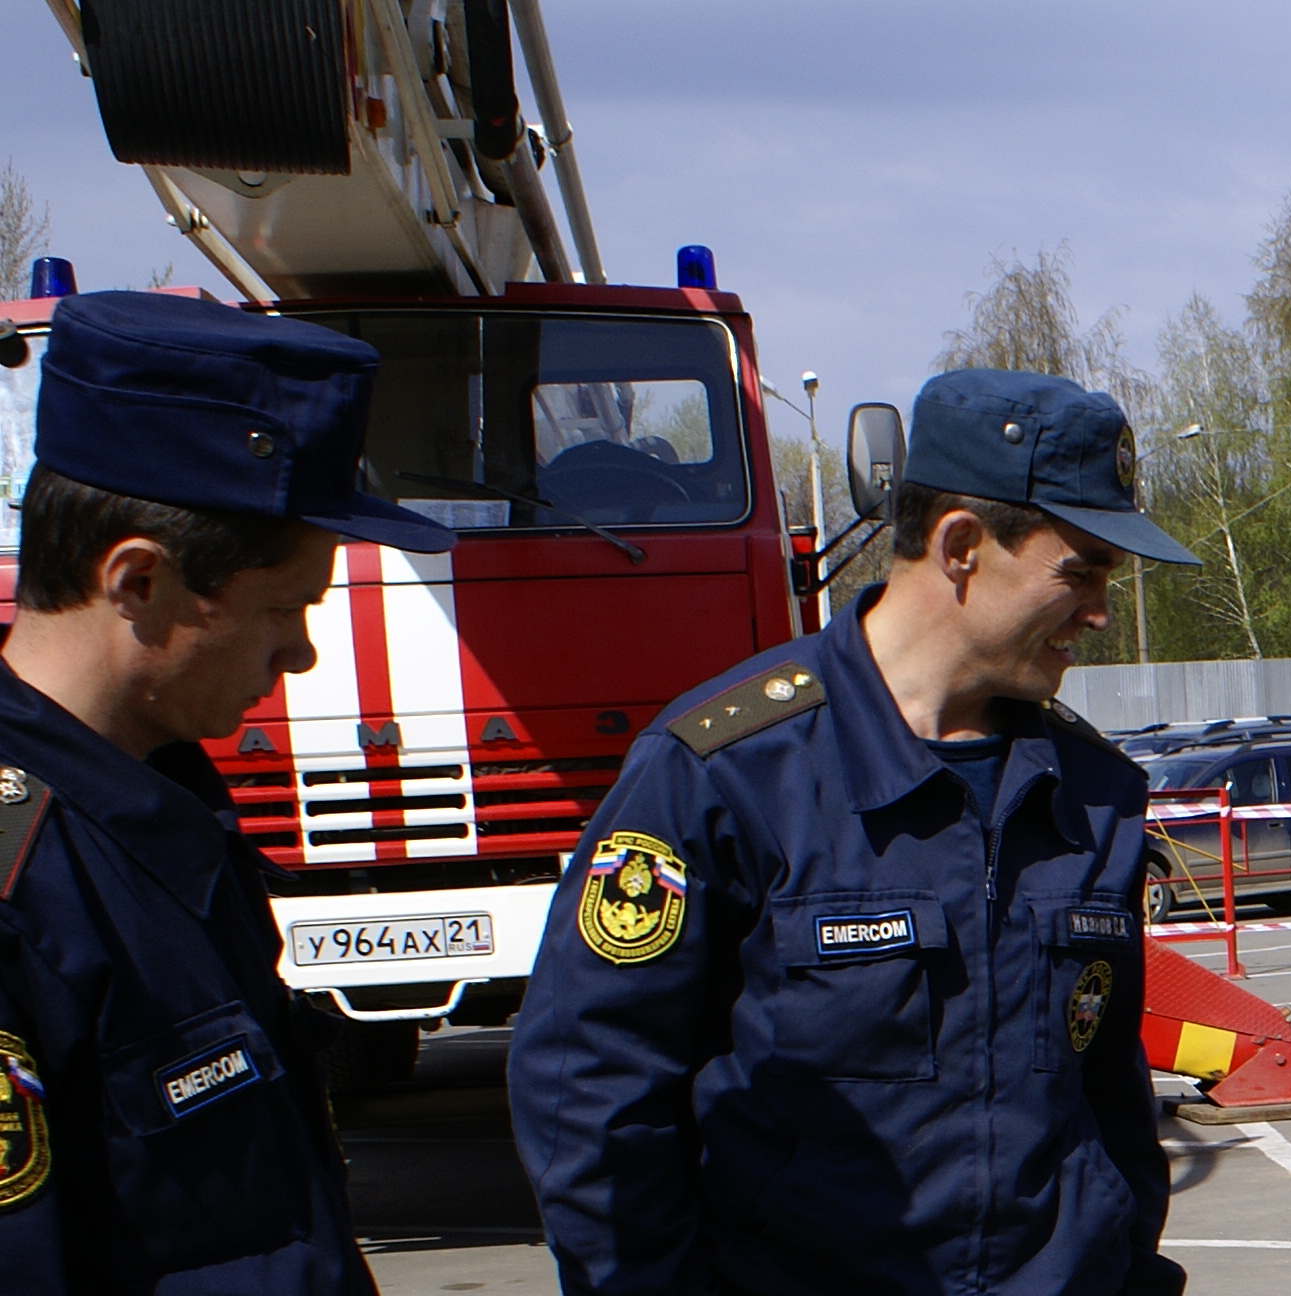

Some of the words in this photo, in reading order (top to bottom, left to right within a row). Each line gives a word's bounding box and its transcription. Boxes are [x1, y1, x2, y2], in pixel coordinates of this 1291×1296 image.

[449, 919, 481, 943] 21
[821, 920, 908, 944] EMERCOM
[448, 942, 473, 953] RUS
[166, 1050, 249, 1104] EMERCOM
